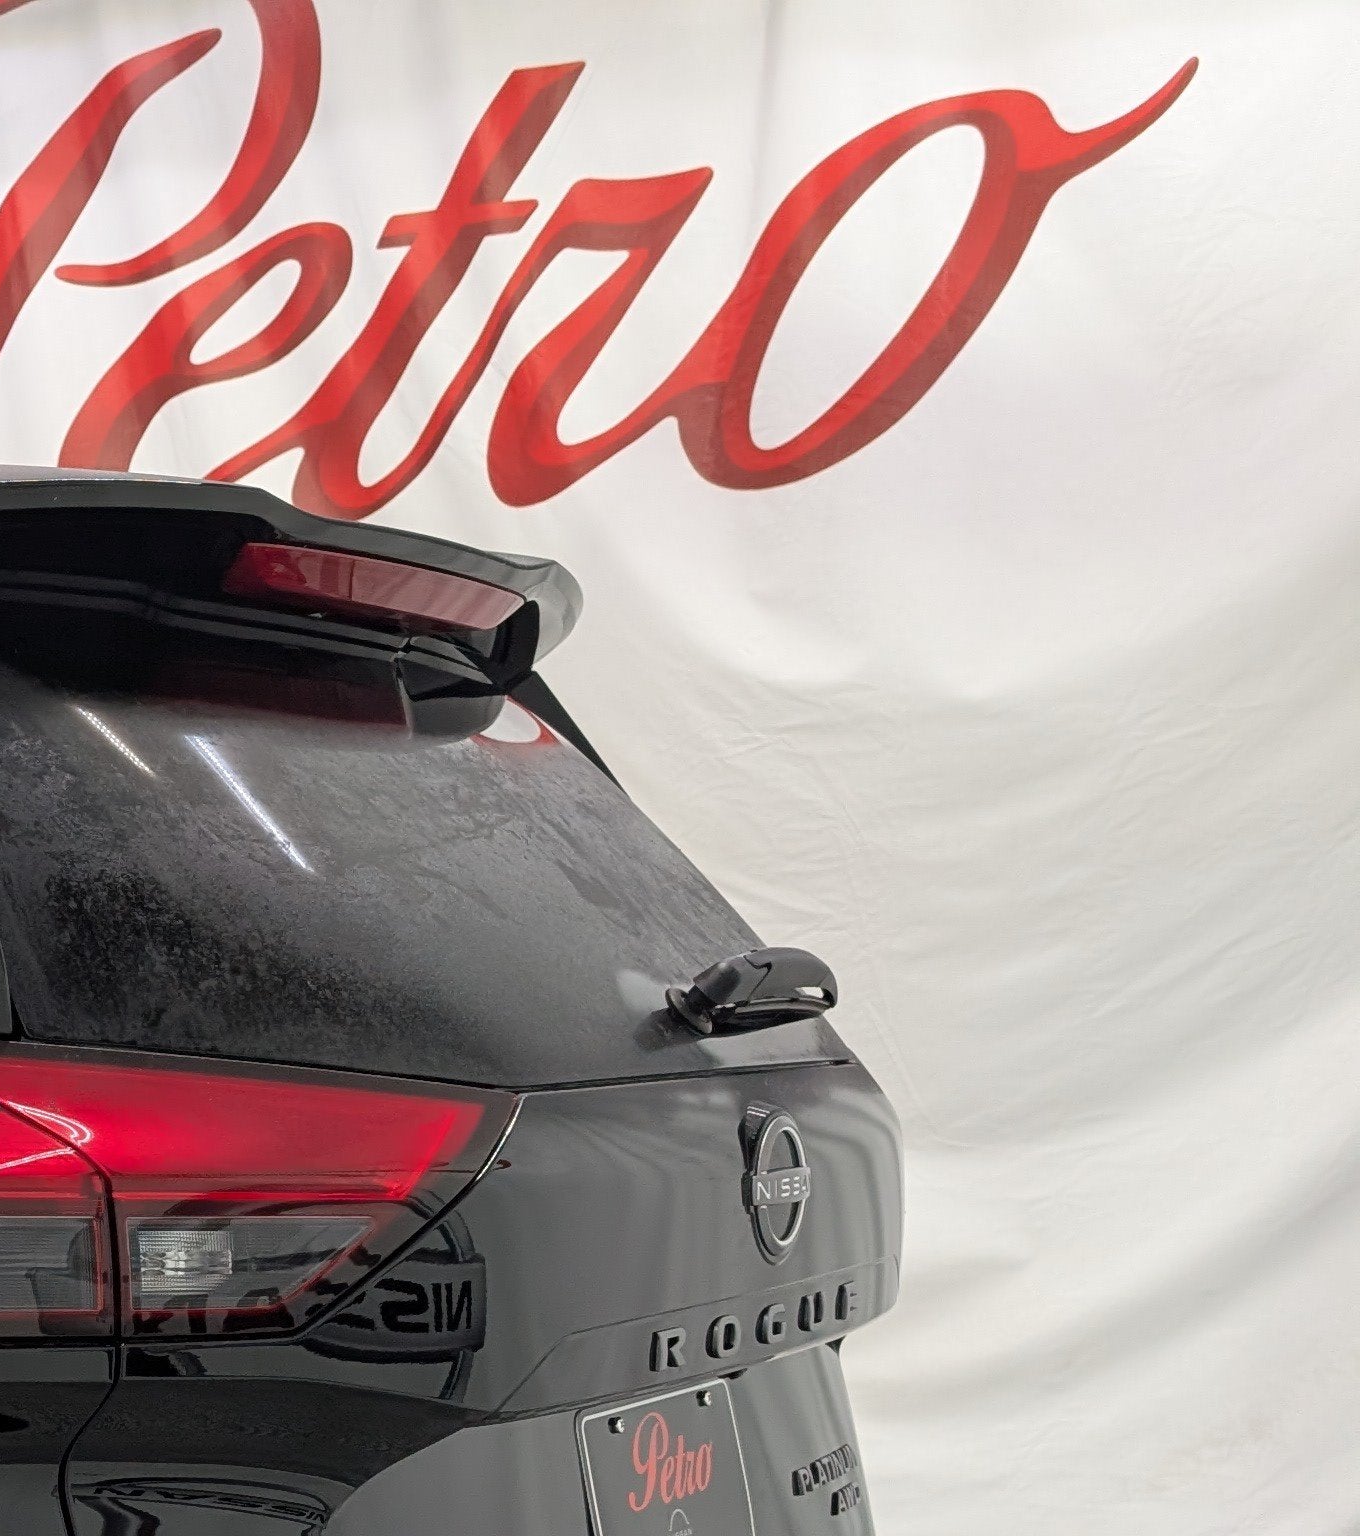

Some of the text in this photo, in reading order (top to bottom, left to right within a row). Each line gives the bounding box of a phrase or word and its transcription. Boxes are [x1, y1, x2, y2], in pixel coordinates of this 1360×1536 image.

[756, 1173, 810, 1201] NISSA
[649, 1280, 857, 1373] ROGUE
[628, 1411, 713, 1512] Petro
